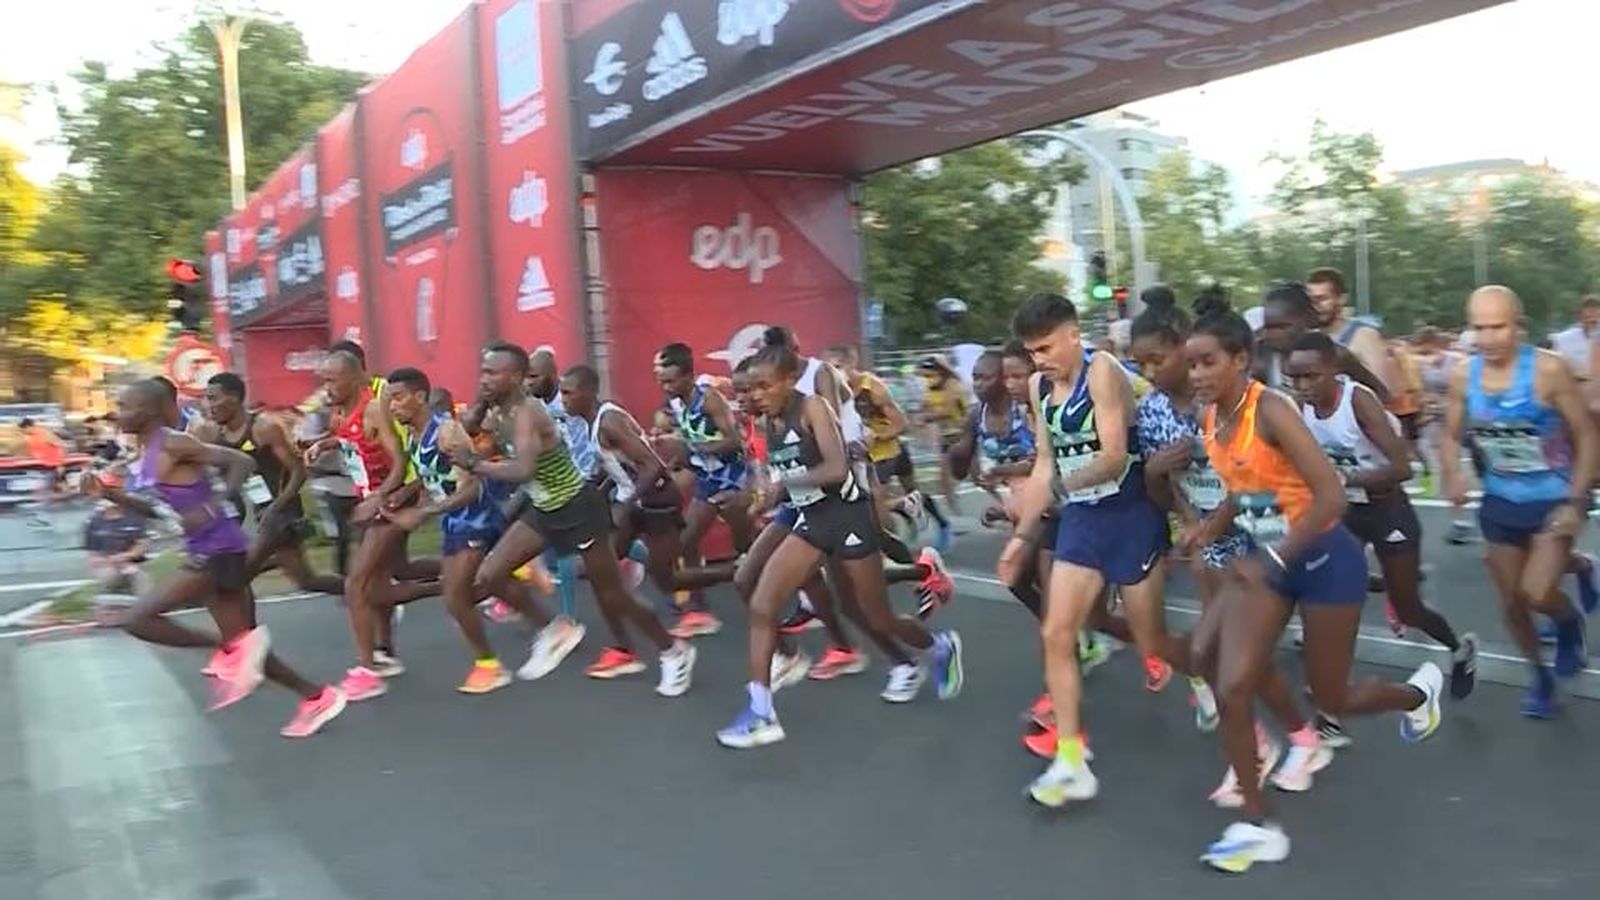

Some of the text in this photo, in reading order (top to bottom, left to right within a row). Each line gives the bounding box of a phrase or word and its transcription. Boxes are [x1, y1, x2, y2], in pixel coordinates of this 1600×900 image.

[670, 64, 959, 154] VUELVE
[947, 38, 1046, 67] A
[690, 212, 783, 284] edp
